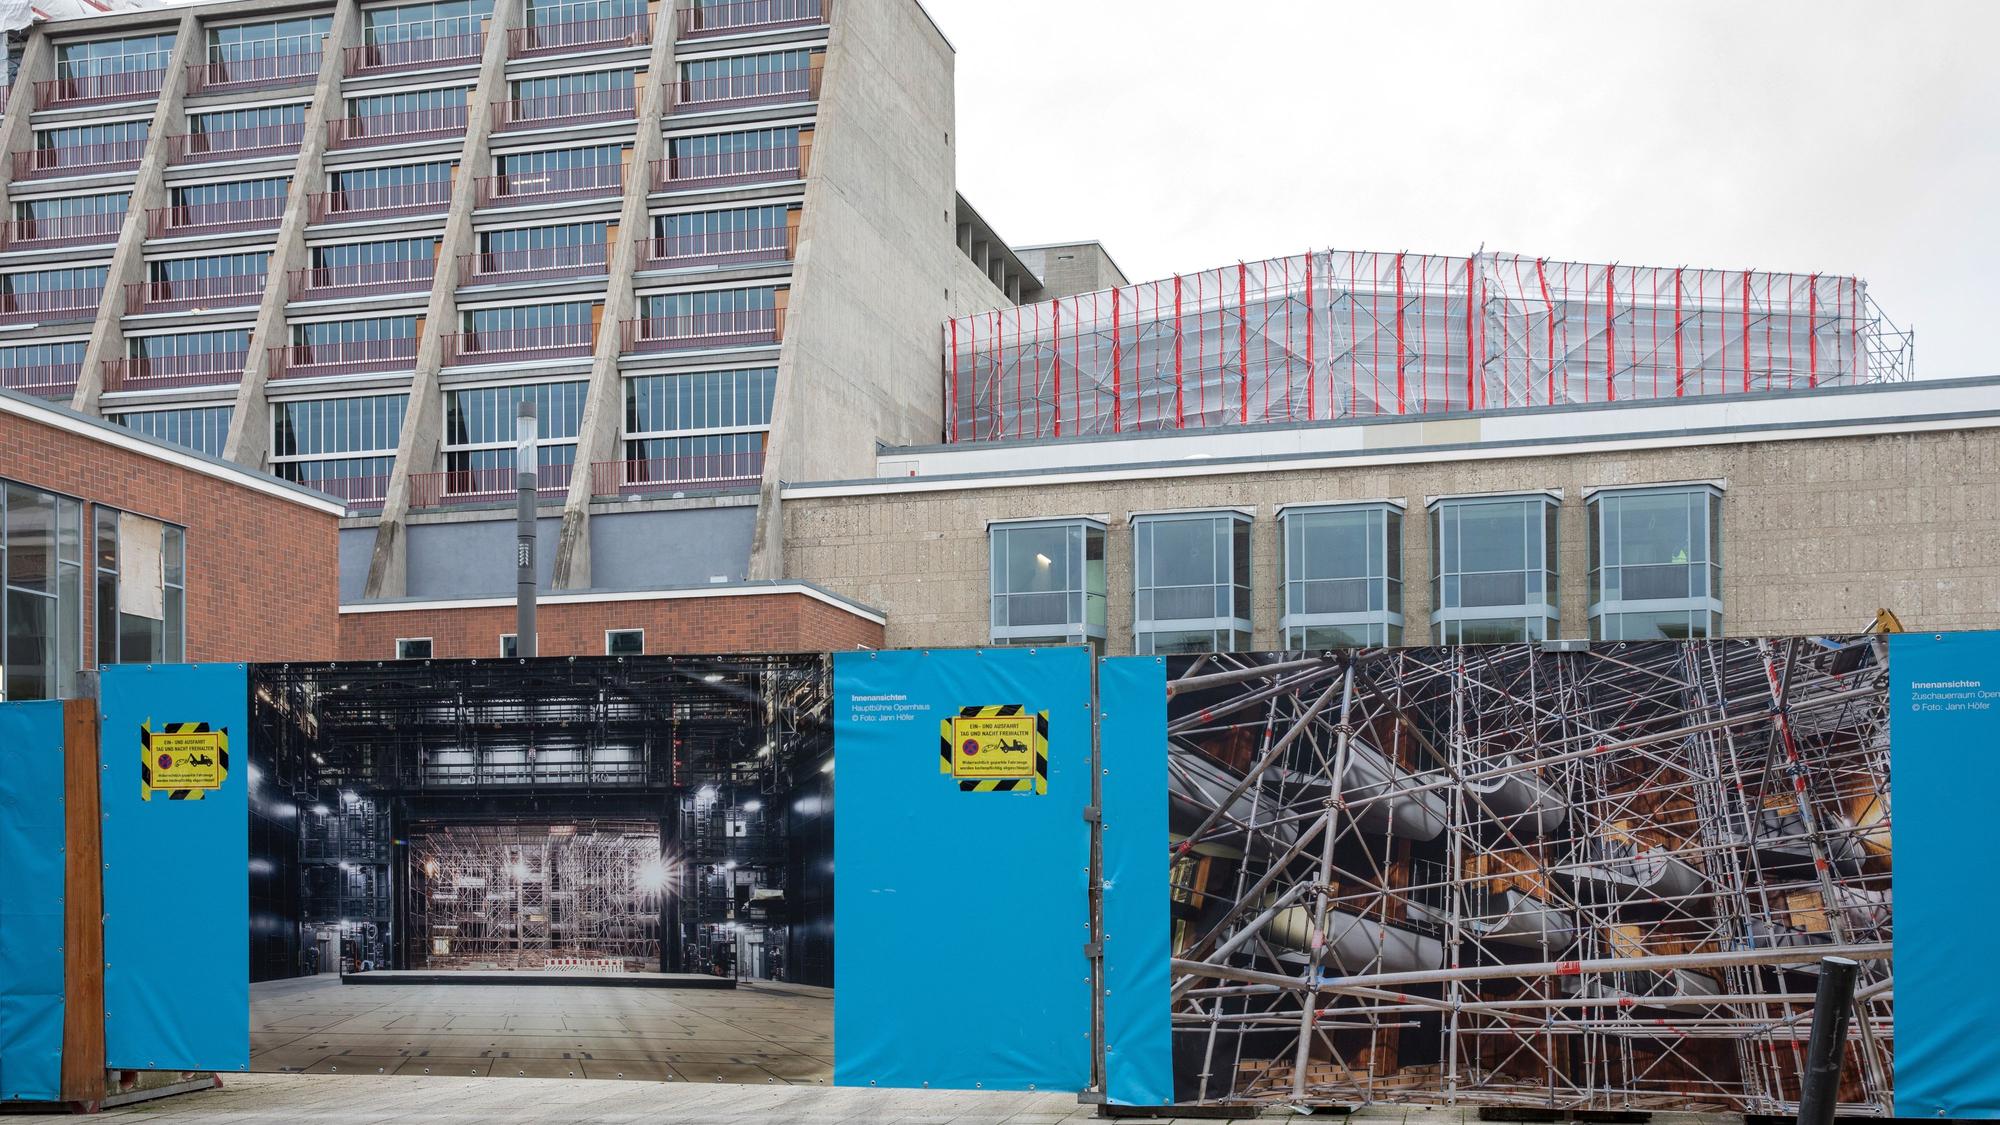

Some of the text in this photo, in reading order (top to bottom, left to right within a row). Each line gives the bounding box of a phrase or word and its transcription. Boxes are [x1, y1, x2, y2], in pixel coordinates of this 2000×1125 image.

[1912, 680, 1980, 688] Innenansichten
[1912, 692, 1976, 700] Zuschauerraum
[852, 704, 930, 712] Hauptbühne Opernhaus
[1946, 702, 1966, 711] Jann
[1968, 702, 1990, 710] Höfer
